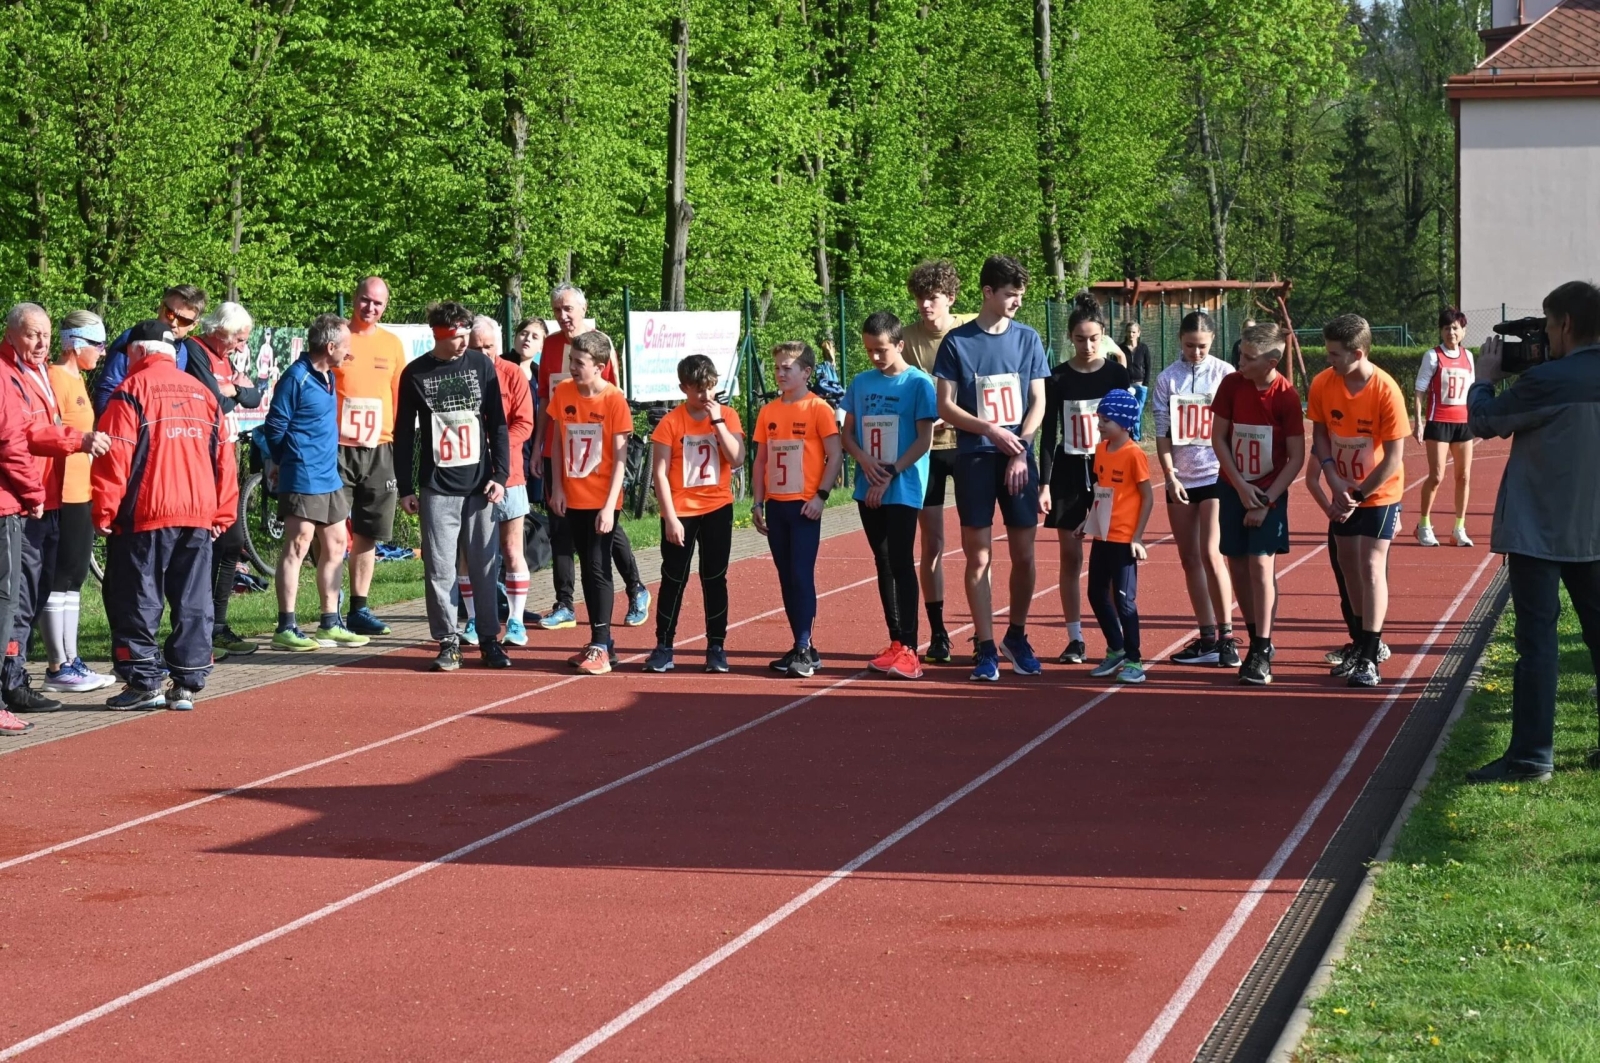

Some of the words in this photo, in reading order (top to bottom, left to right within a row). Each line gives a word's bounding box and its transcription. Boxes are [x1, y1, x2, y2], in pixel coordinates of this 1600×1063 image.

[983, 386, 1016, 424] 50
[1447, 376, 1466, 399] 87
[350, 410, 376, 442] 59
[1177, 404, 1213, 440] 108
[439, 425, 471, 461] 60
[569, 437, 593, 472] 17
[1234, 438, 1261, 475] 68
[698, 444, 711, 479] 2
[776, 452, 787, 486] 5
[1336, 449, 1365, 480] 66
